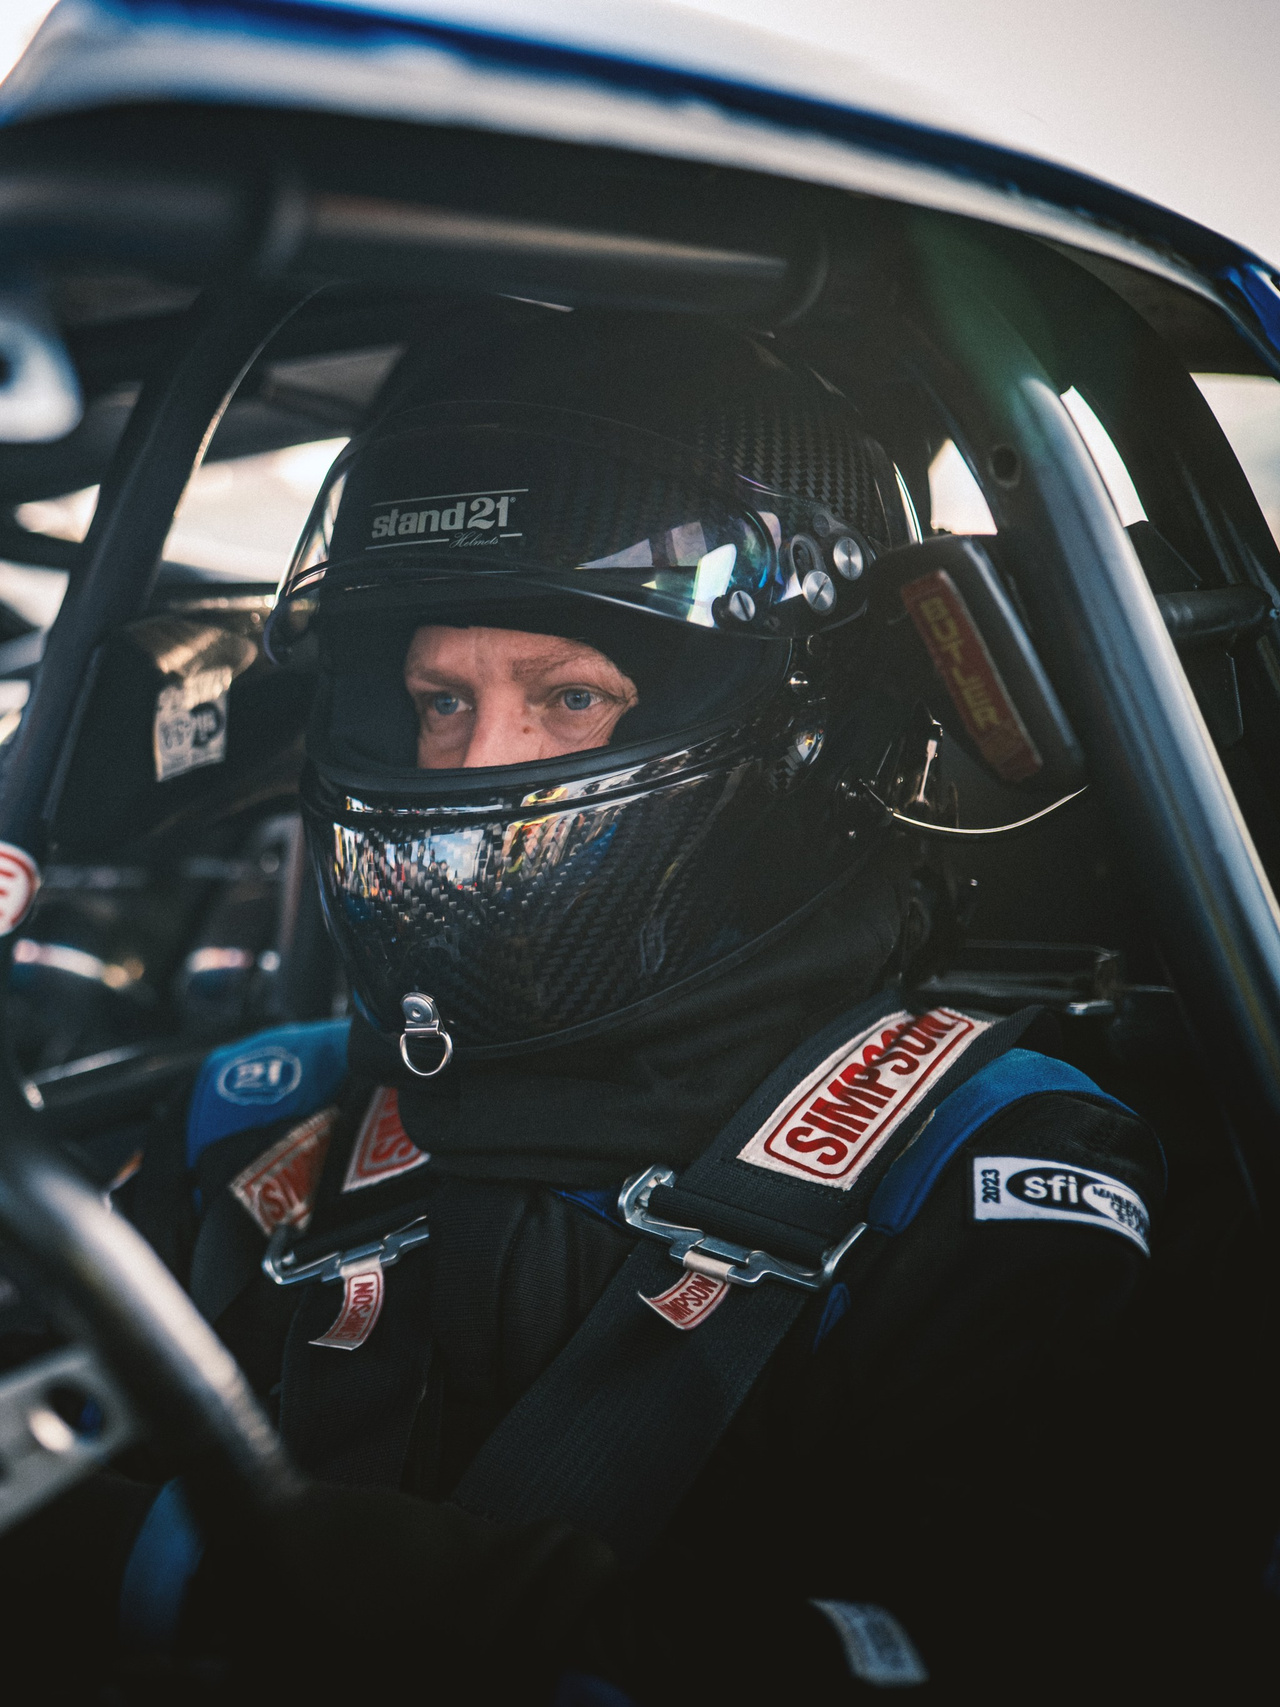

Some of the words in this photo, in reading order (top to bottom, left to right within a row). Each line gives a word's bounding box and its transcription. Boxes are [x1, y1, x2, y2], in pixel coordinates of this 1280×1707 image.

[449, 531, 499, 548] Helmets
[235, 1060, 283, 1089] 21
[785, 1014, 960, 1166] SIMPSON
[981, 1169, 1001, 1204] 2023
[1024, 1175, 1079, 1203] sfi
